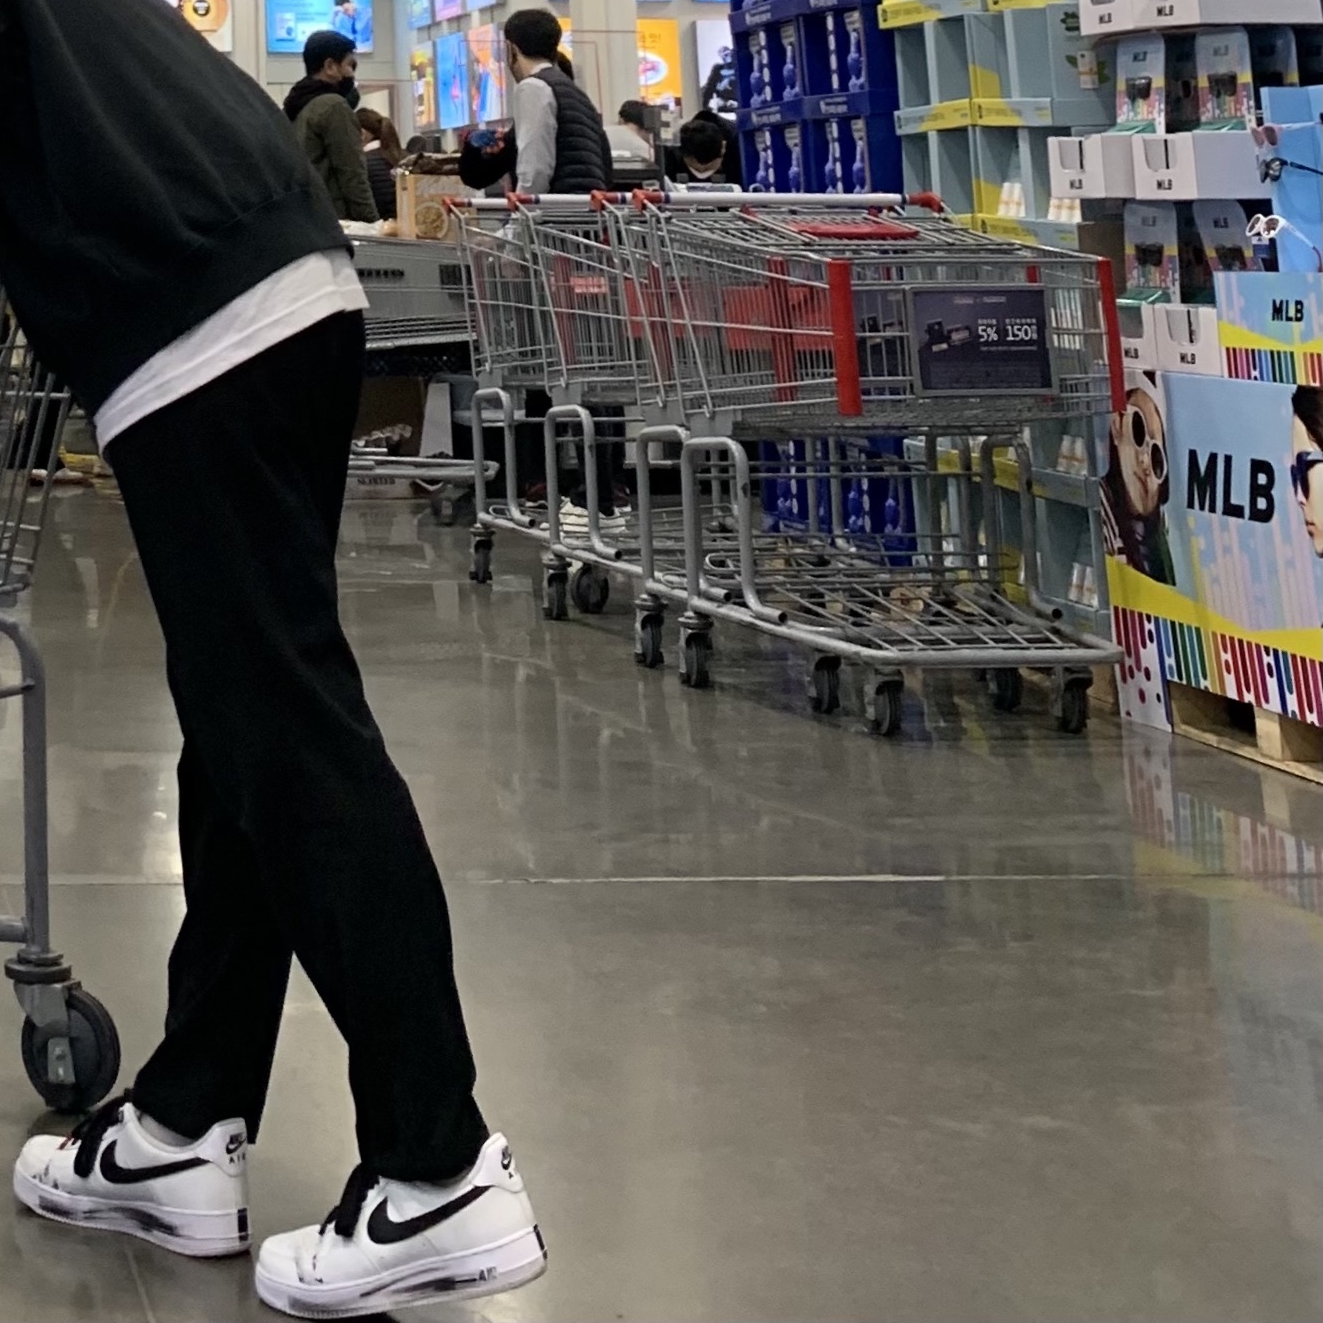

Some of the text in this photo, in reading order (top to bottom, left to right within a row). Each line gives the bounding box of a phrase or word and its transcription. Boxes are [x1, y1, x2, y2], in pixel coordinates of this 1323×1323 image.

[1157, 5, 1174, 17] MLB
[1098, 13, 1112, 24] MLB
[1069, 179, 1083, 190] MLB
[1157, 179, 1173, 190] MLB
[1272, 299, 1305, 323] MLB
[978, 325, 999, 342] 5%
[1123, 348, 1139, 359] MLB
[1180, 353, 1196, 364] MLB
[1186, 449, 1276, 524] MLB
